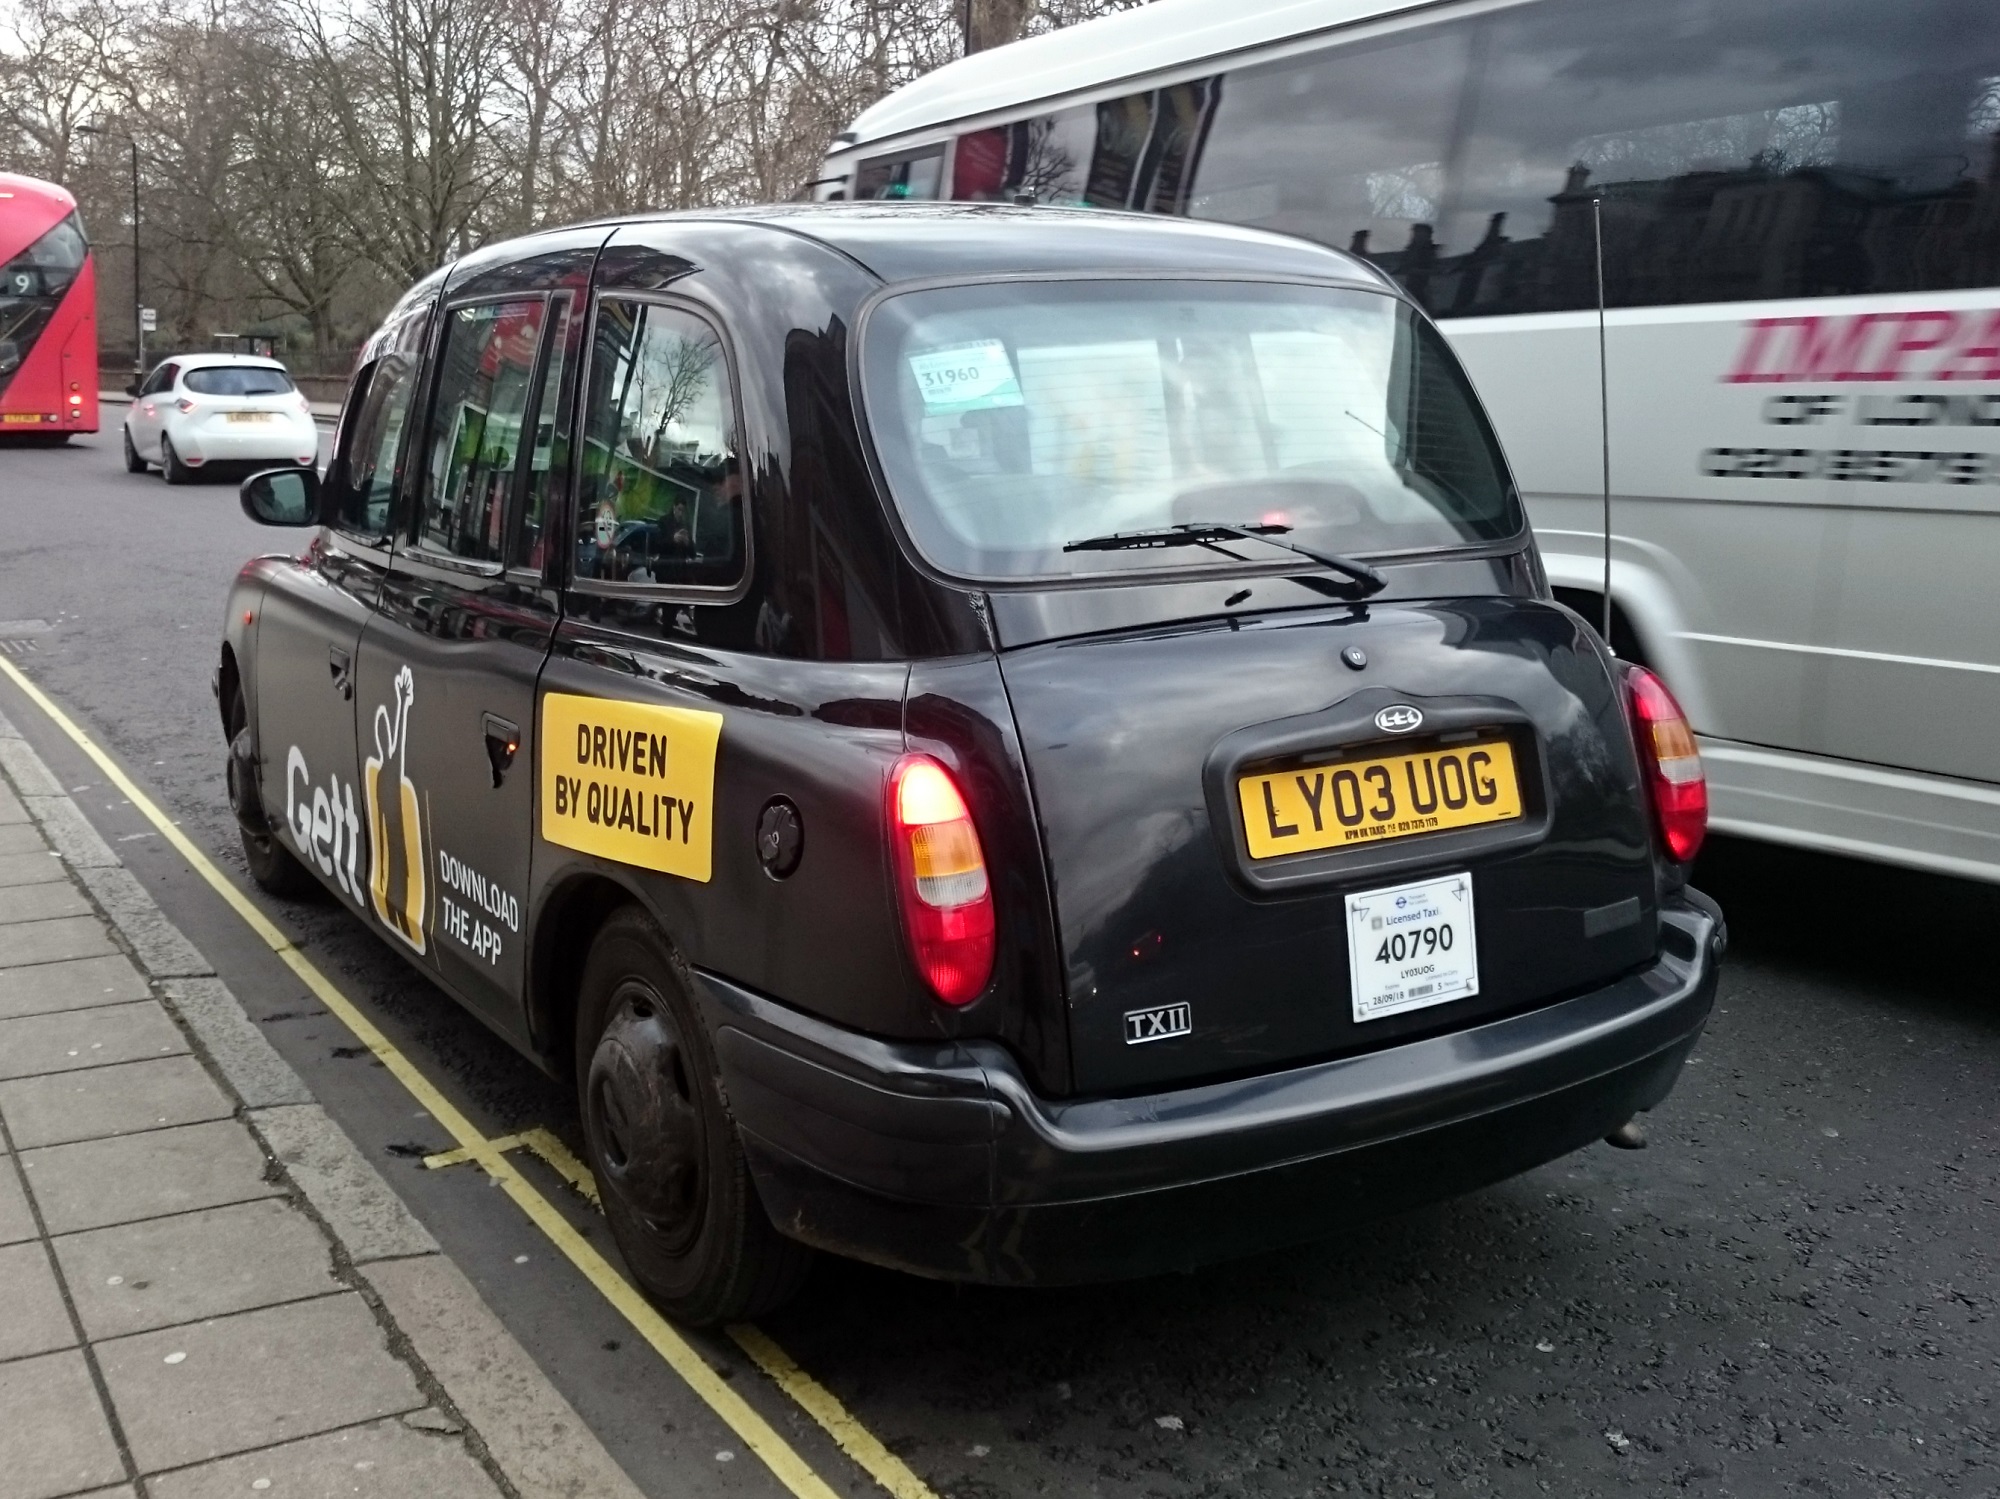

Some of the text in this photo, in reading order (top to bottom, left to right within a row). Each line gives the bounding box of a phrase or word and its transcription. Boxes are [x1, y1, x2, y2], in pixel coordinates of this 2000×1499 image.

[15, 274, 29, 294] 9
[921, 366, 979, 387] 31960
[577, 723, 667, 780] DRIVEN
[555, 774, 694, 845] BY QUALITY
[1262, 751, 1498, 840] LY03 UOG
[287, 744, 365, 908] Gett
[1345, 829, 1360, 840] KPM
[1360, 828, 1369, 838] UK
[1369, 825, 1386, 836] TAXIS
[1398, 821, 1410, 831] 020
[440, 850, 518, 933] DOWNLOAD
[1386, 905, 1440, 925] Licensed Taxi
[443, 896, 502, 966] THE APP
[1374, 923, 1453, 964] 40790
[1401, 964, 1435, 979] LY03UOG
[1437, 982, 1443, 990] 5
[1372, 992, 1405, 1005] 28/09/18
[1128, 1007, 1187, 1038] TXII
